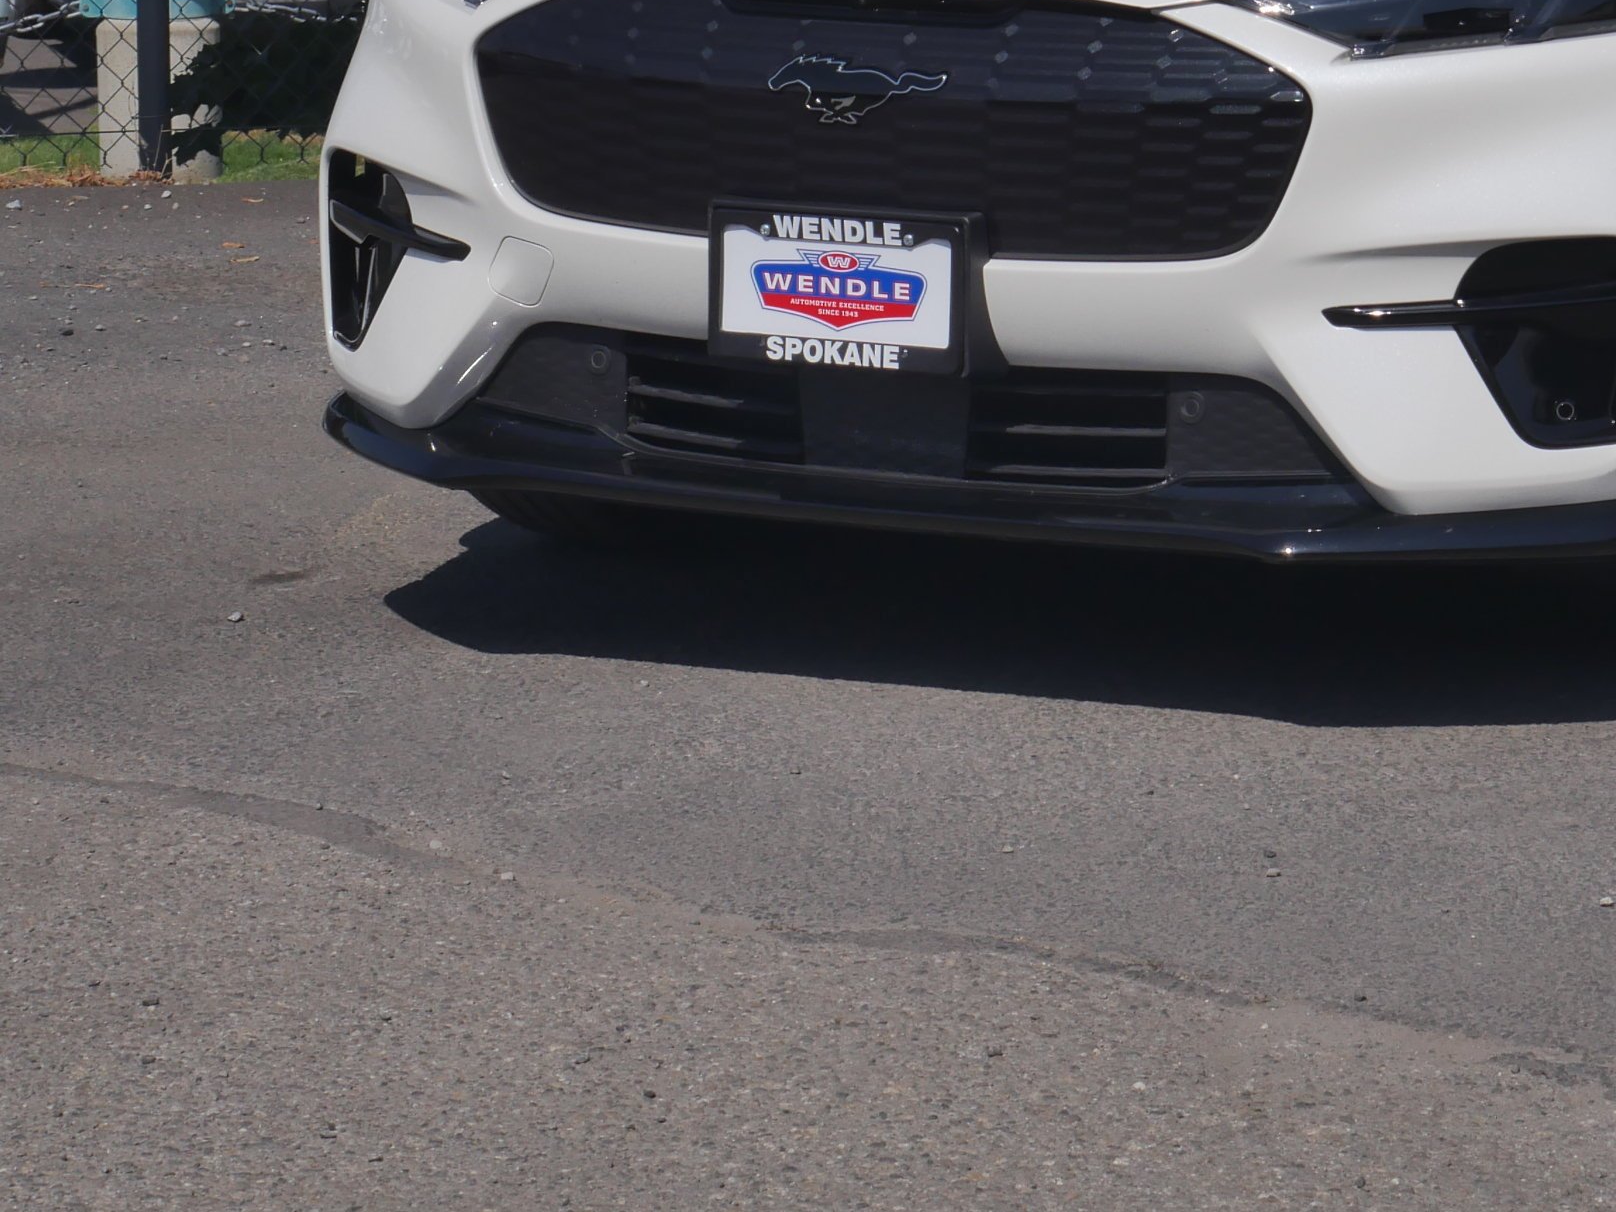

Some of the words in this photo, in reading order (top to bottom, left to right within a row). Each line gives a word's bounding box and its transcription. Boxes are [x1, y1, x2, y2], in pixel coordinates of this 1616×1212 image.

[773, 214, 902, 246] WENDLE
[764, 272, 910, 300] WENDLE
[790, 298, 837, 308] AUTOMOTIVE
[839, 301, 884, 311] EXCELLENCE
[818, 308, 840, 317] SINCE
[841, 309, 859, 318] 1943
[766, 336, 900, 370] SPOKANE
